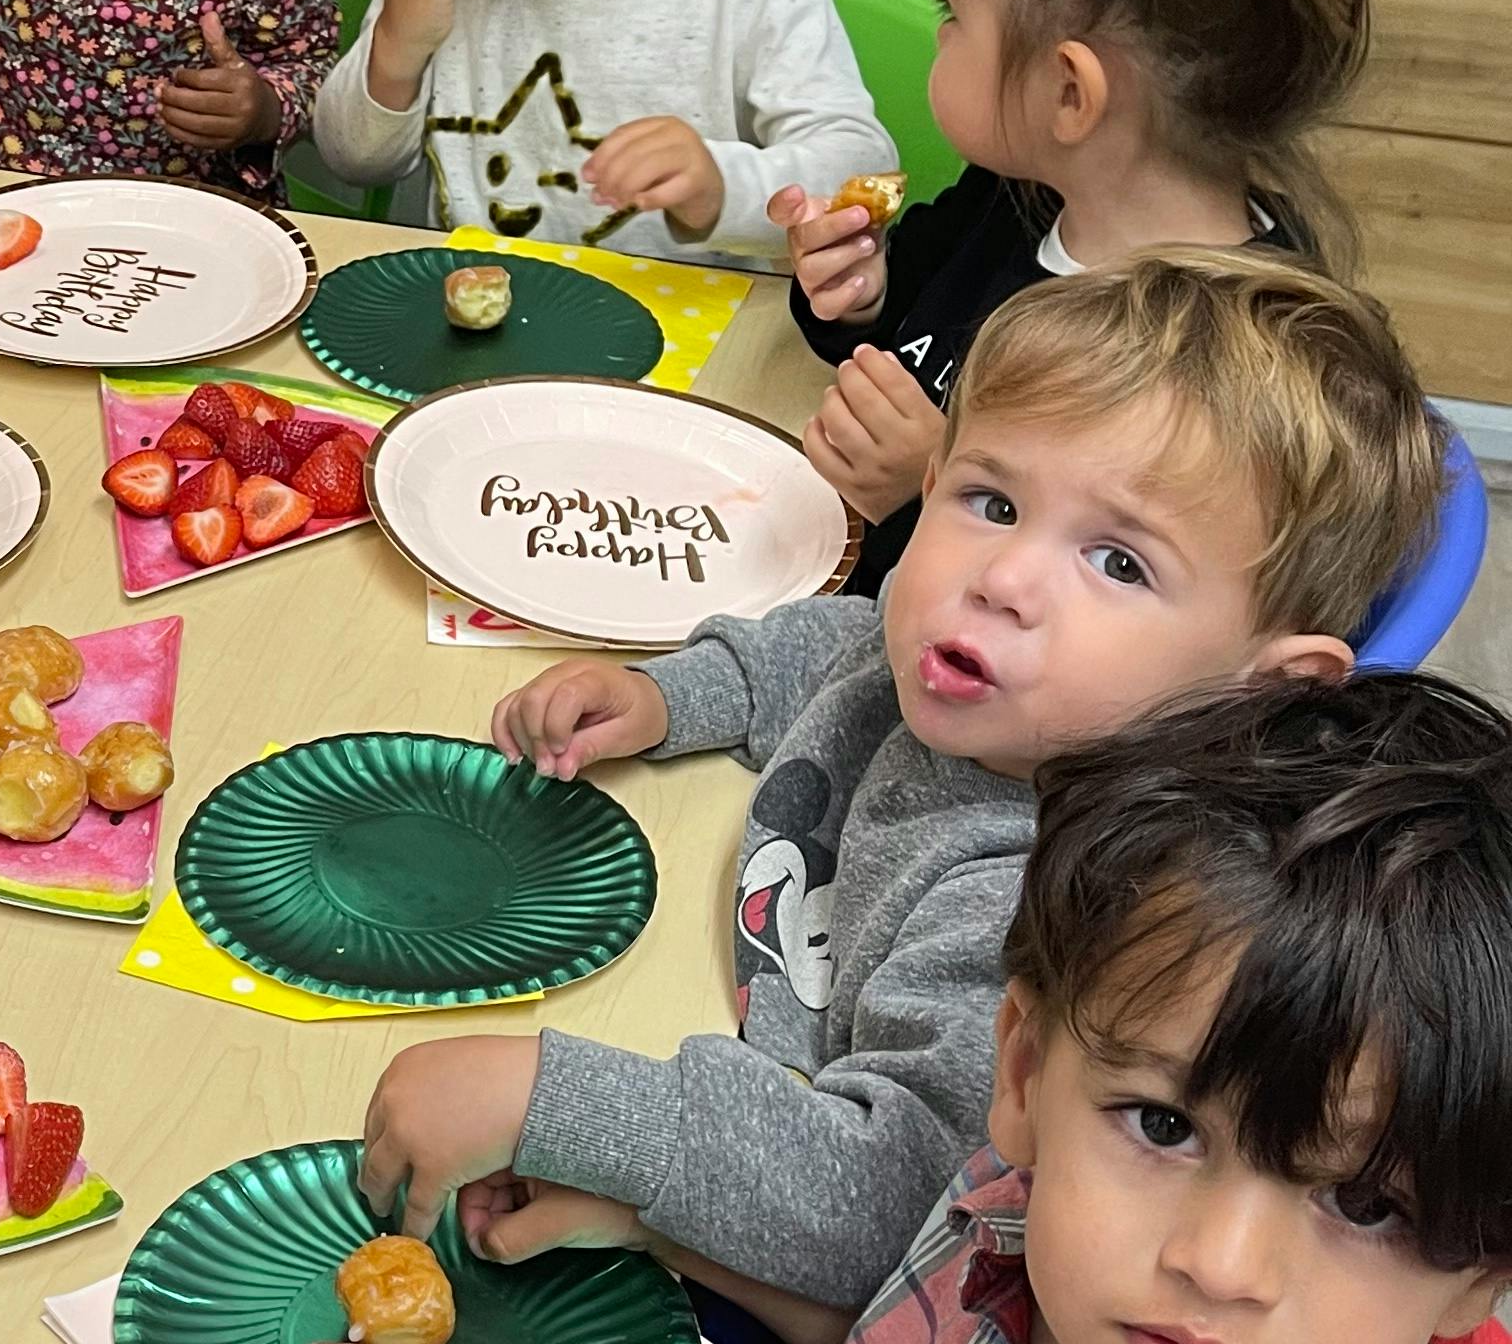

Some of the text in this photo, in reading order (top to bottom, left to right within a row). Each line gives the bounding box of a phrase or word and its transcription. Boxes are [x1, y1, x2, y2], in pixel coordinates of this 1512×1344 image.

[0, 247, 148, 338] Birthday
[82, 264, 198, 334] Happy
[480, 474, 731, 544] Birthday
[526, 524, 707, 583] Happy
